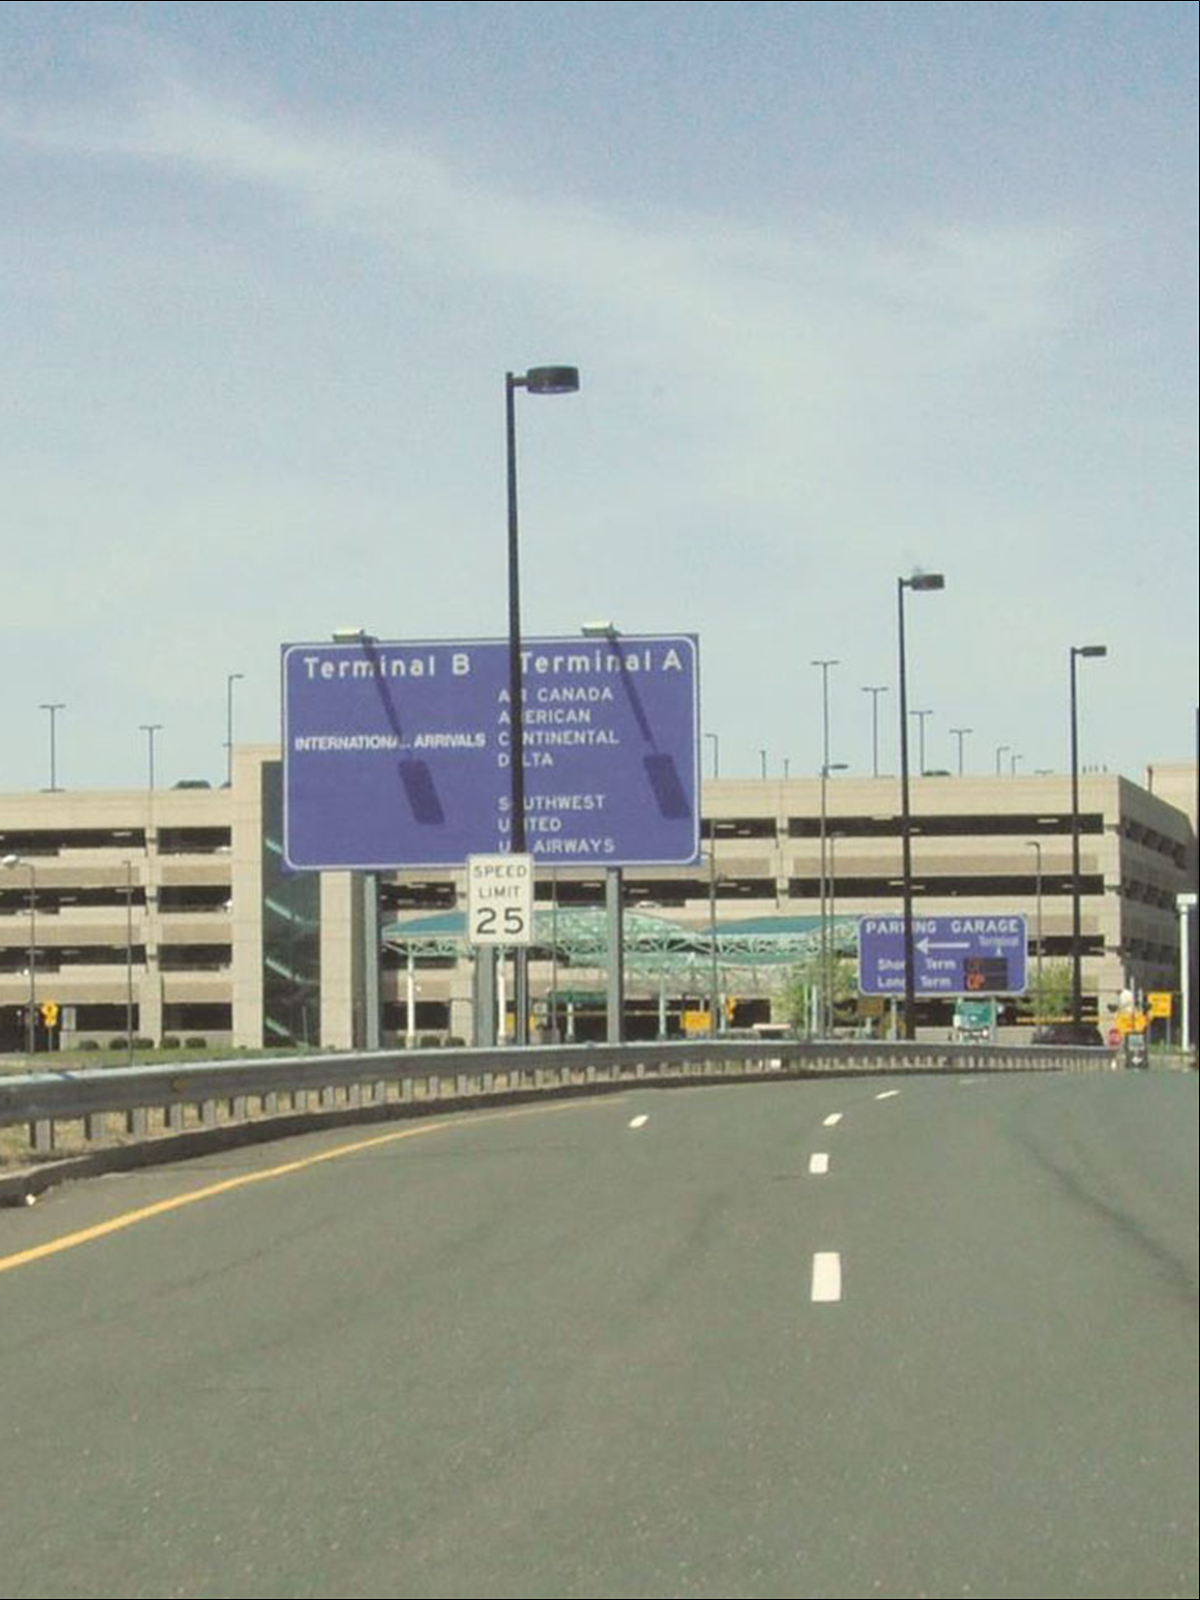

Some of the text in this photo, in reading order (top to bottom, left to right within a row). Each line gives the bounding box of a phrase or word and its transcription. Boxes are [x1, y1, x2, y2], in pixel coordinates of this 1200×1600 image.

[304, 653, 470, 679] Terminal B
[520, 649, 682, 674] Terminal A
[537, 687, 614, 703] CANADA
[498, 709, 591, 726] AERICAN
[414, 732, 486, 748] ARRIVALS
[498, 730, 620, 747] CNTINENTAL
[498, 752, 555, 768] DLTA
[498, 795, 606, 812] SUTHWEST
[498, 817, 562, 833] UITED
[534, 838, 616, 855] AIRWAYS
[473, 864, 528, 879] SPEED
[478, 885, 522, 899] LIMIT
[476, 906, 524, 935] 25
[951, 919, 1019, 933] GARAGE
[925, 958, 956, 970] Term
[920, 976, 951, 988] Term
